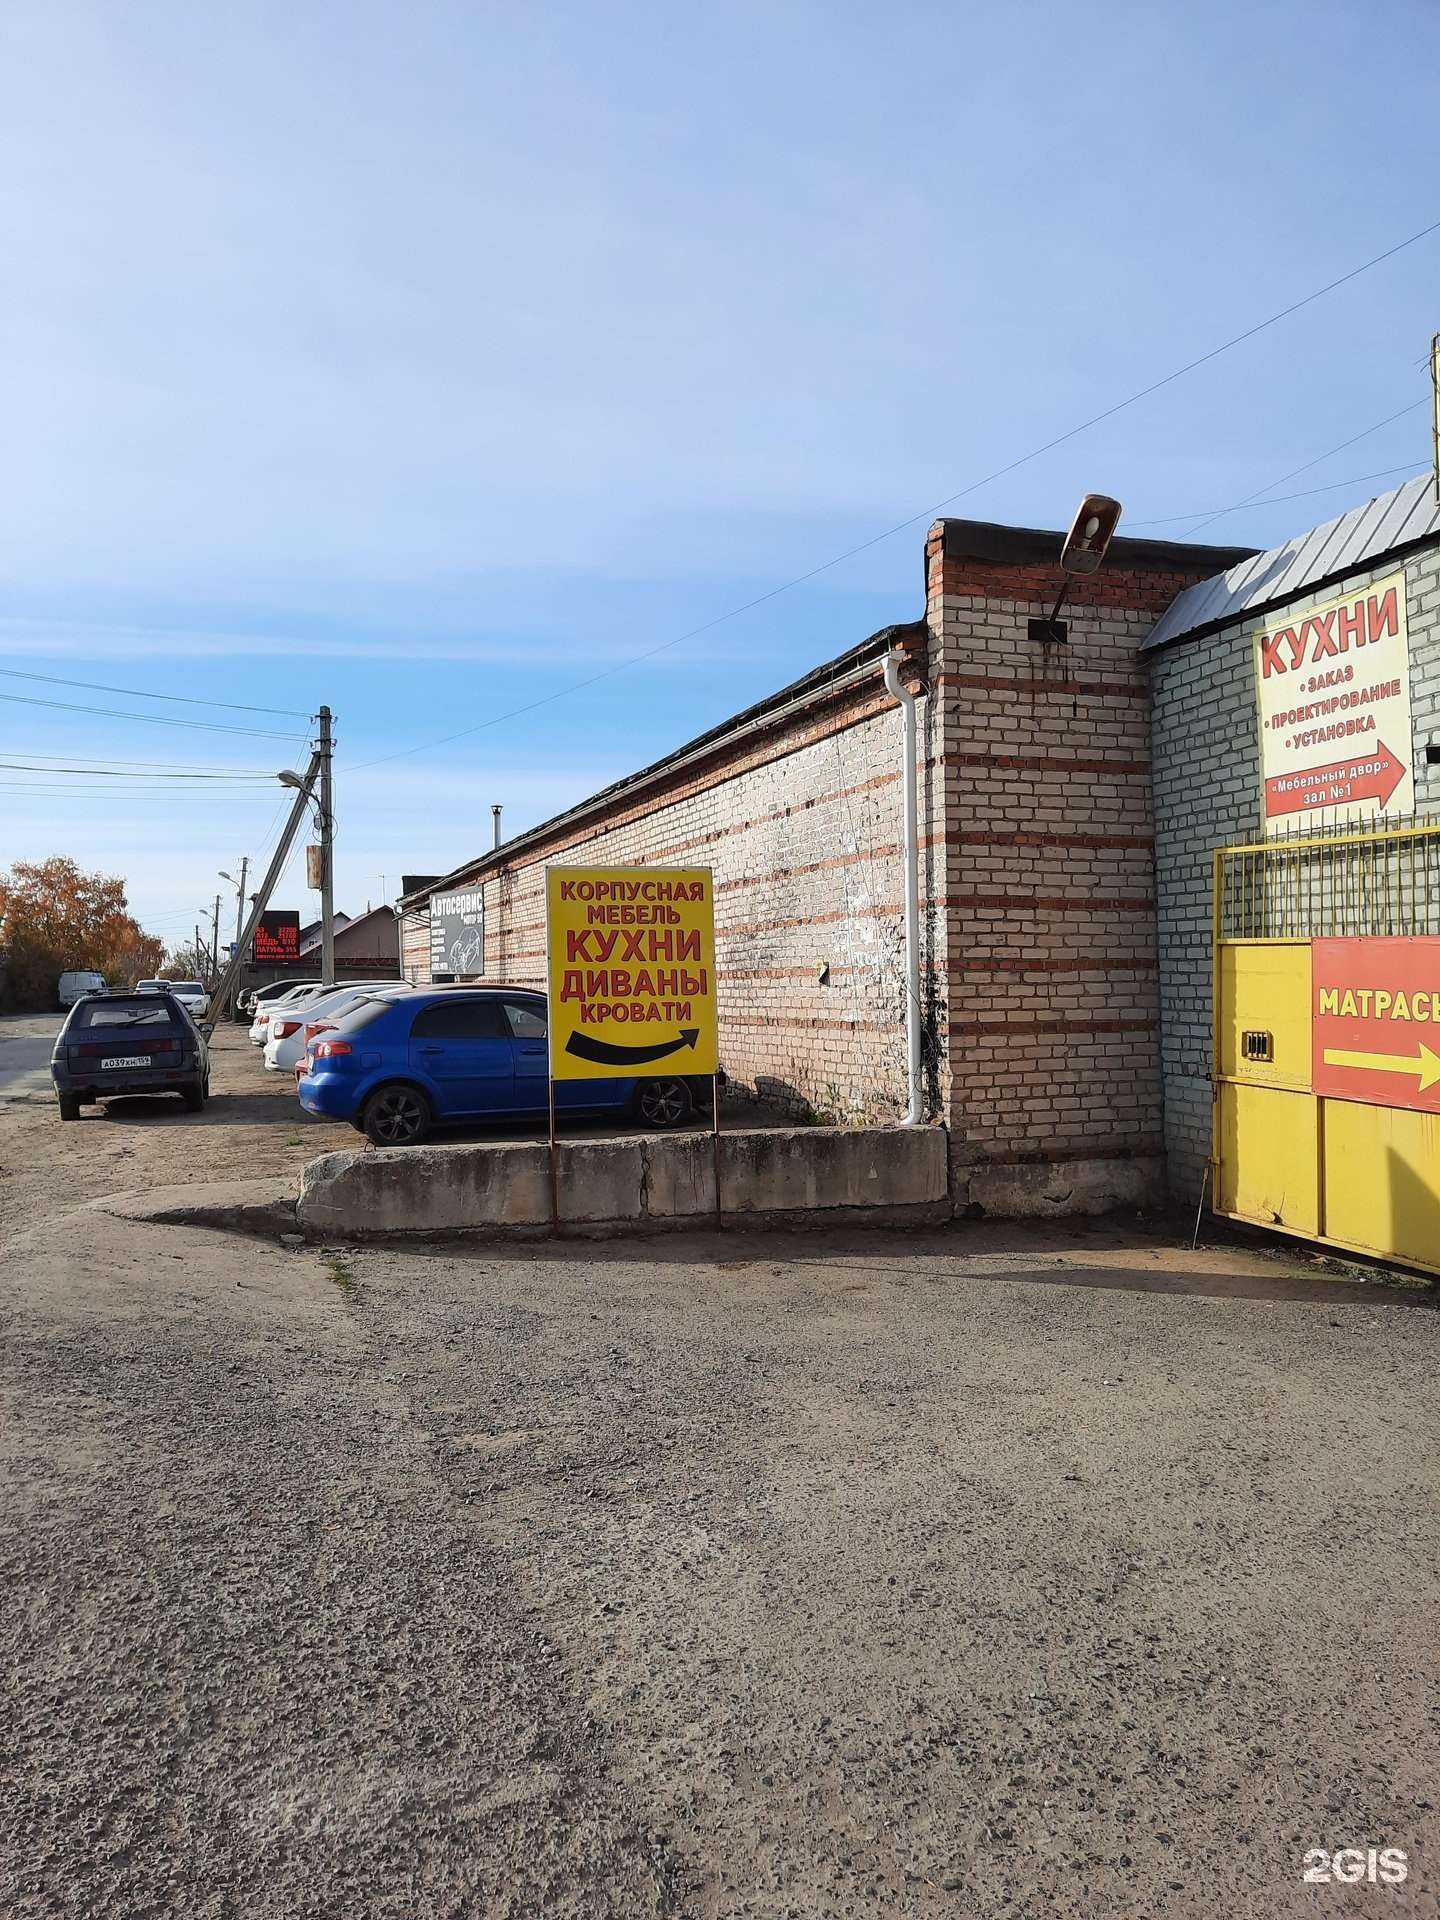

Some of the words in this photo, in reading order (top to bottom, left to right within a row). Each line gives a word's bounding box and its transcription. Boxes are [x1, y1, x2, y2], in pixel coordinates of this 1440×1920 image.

[1261, 587, 1399, 680] КУХНИ
[1307, 665, 1354, 692] ЗАКАЗ
[1271, 679, 1401, 730] ПРОЕКТИРОВАНИЕ
[1293, 715, 1376, 749] УСТАНОВКА
[1303, 789, 1326, 804] зал
[560, 880, 704, 901] КОРПУСНАЯ
[587, 904, 681, 925] МЕБЕЛЬ
[566, 929, 701, 963] КУХНИ
[560, 968, 708, 1003] ДИВАНЫ
[580, 1001, 692, 1023] КРОВАТИ
